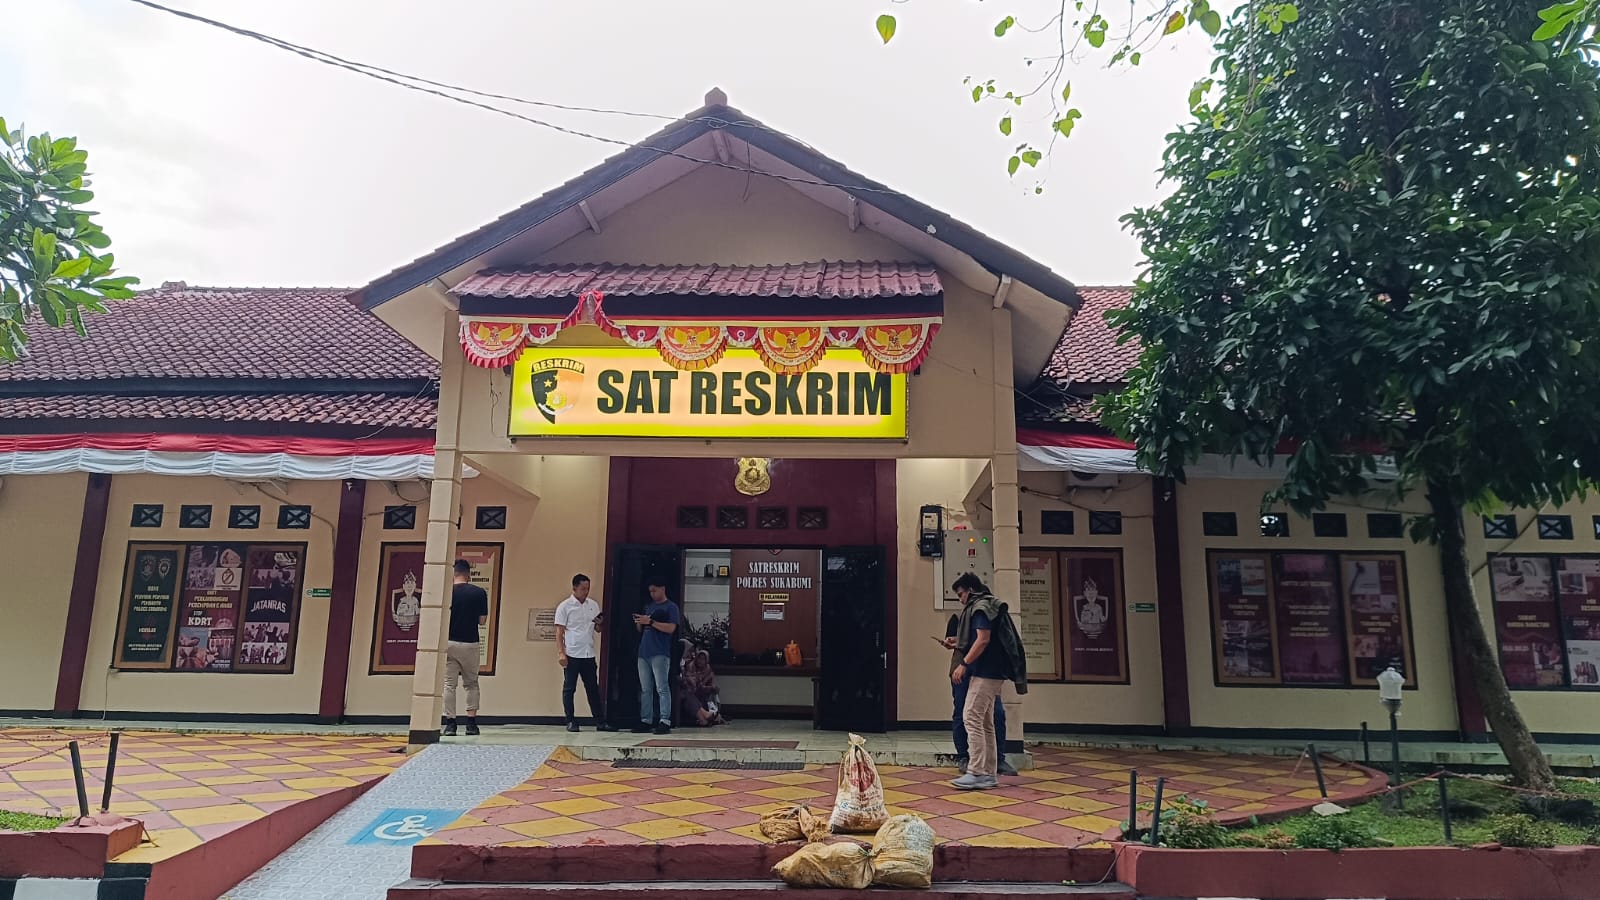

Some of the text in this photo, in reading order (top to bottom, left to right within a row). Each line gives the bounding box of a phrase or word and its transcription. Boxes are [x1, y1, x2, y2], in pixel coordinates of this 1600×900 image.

[532, 359, 584, 372] RESKRIM
[597, 369, 892, 416] SAT RESKRIM
[748, 562, 800, 574] SATRESKRIM
[736, 577, 812, 589] POLRES SUKABUMI
[250, 599, 287, 614] JATANRAS
[187, 616, 213, 626] KDRT
